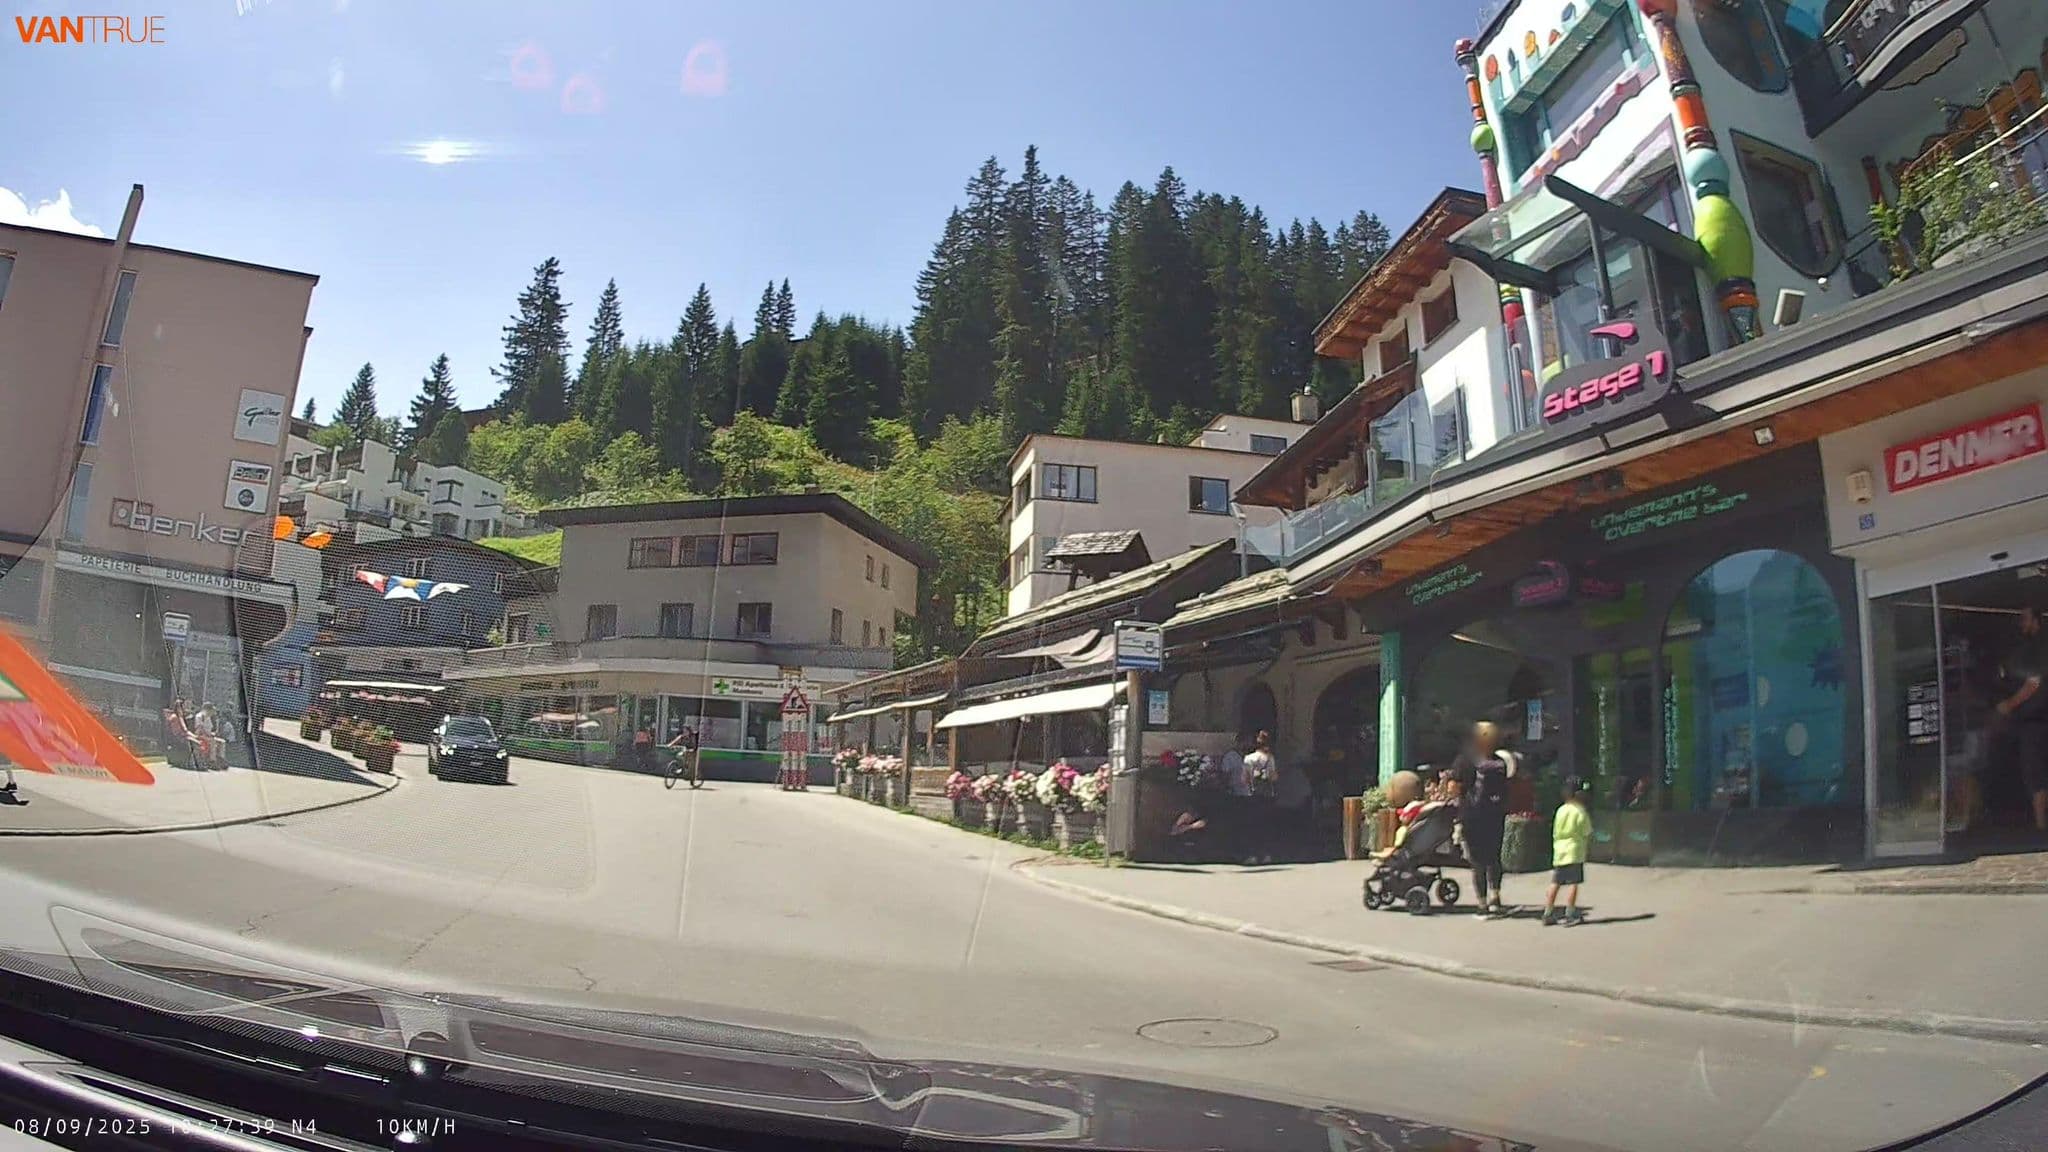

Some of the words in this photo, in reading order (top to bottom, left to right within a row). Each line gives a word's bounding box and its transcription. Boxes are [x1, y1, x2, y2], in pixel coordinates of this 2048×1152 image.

[1645, 350, 1667, 377] 1
[1894, 414, 2038, 484] DENNER
[128, 500, 264, 546] benker
[81, 555, 141, 575] PAPETERIE
[166, 568, 262, 594] BUCHHANDLUNG
